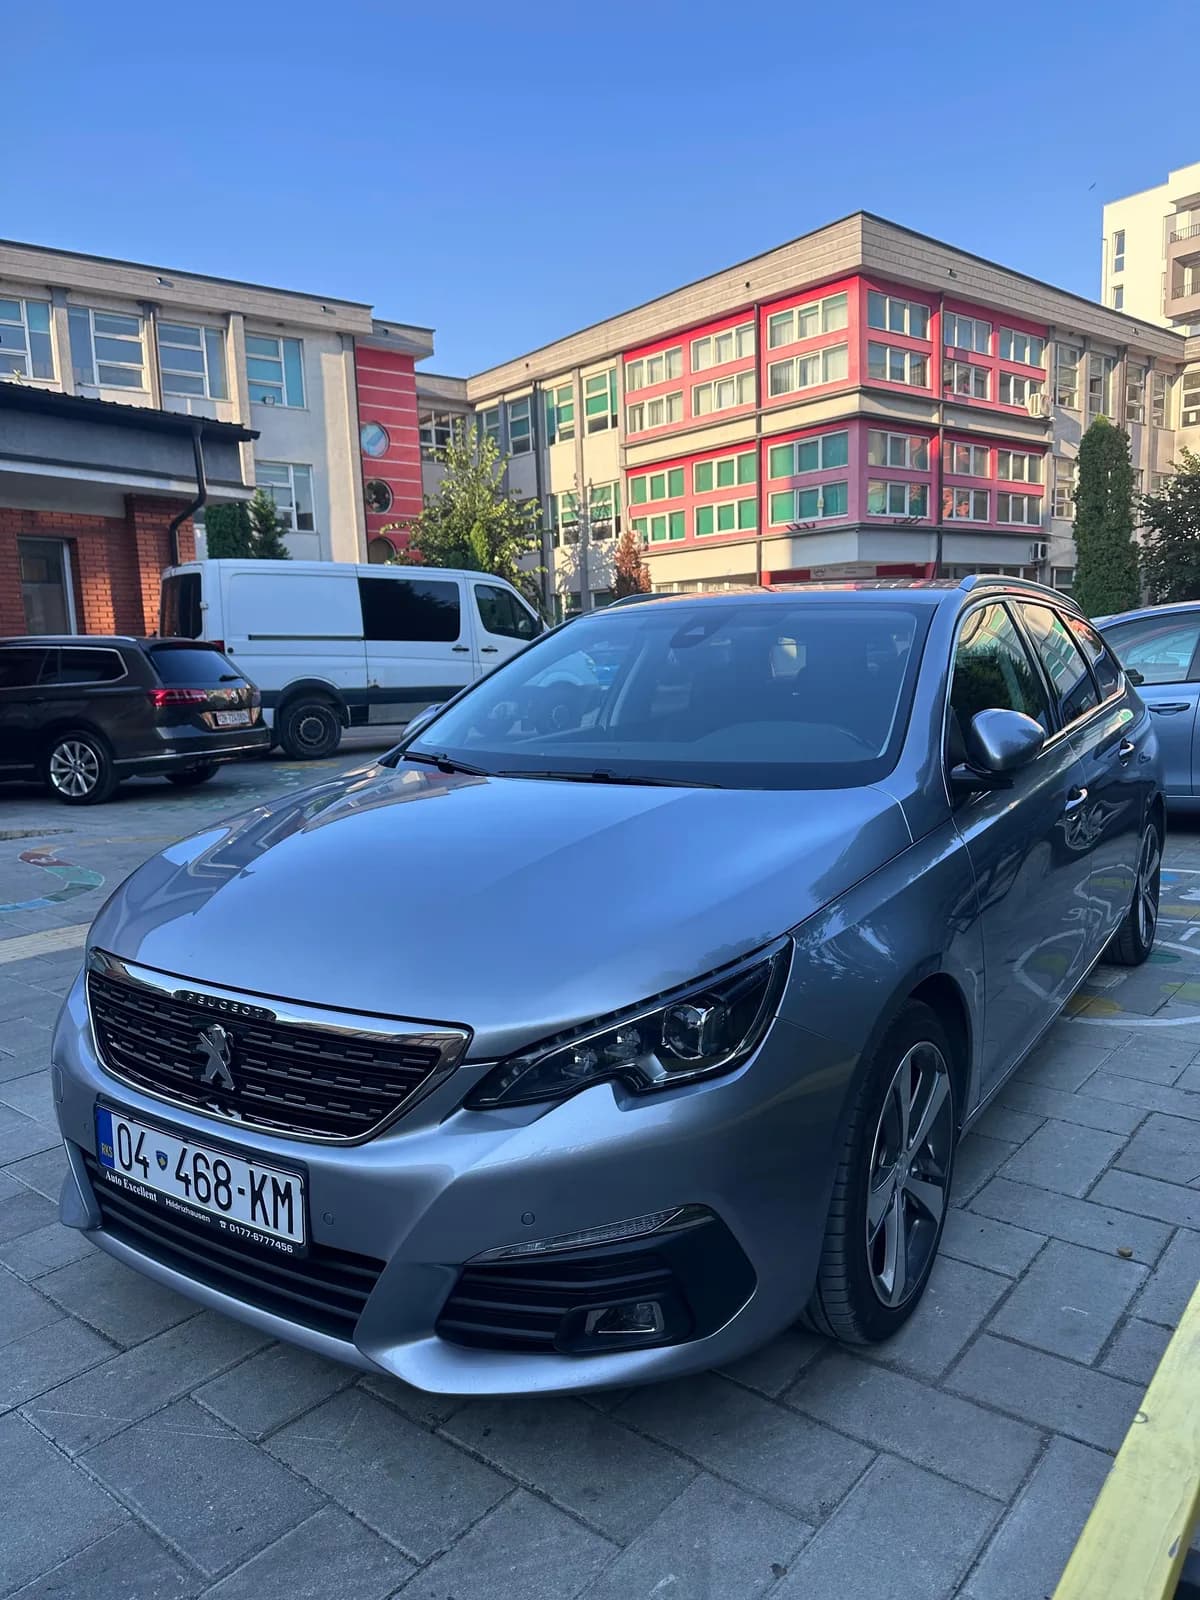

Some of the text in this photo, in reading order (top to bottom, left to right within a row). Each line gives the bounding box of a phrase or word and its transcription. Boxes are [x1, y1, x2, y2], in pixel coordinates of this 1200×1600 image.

[101, 1142, 113, 1158] RKS
[105, 1170, 158, 1203] Auto Excellent
[117, 1122, 295, 1235] 04 468-KM
[165, 1198, 211, 1223] Hildrizhausen
[229, 1222, 293, 1253] 0177-6777456
